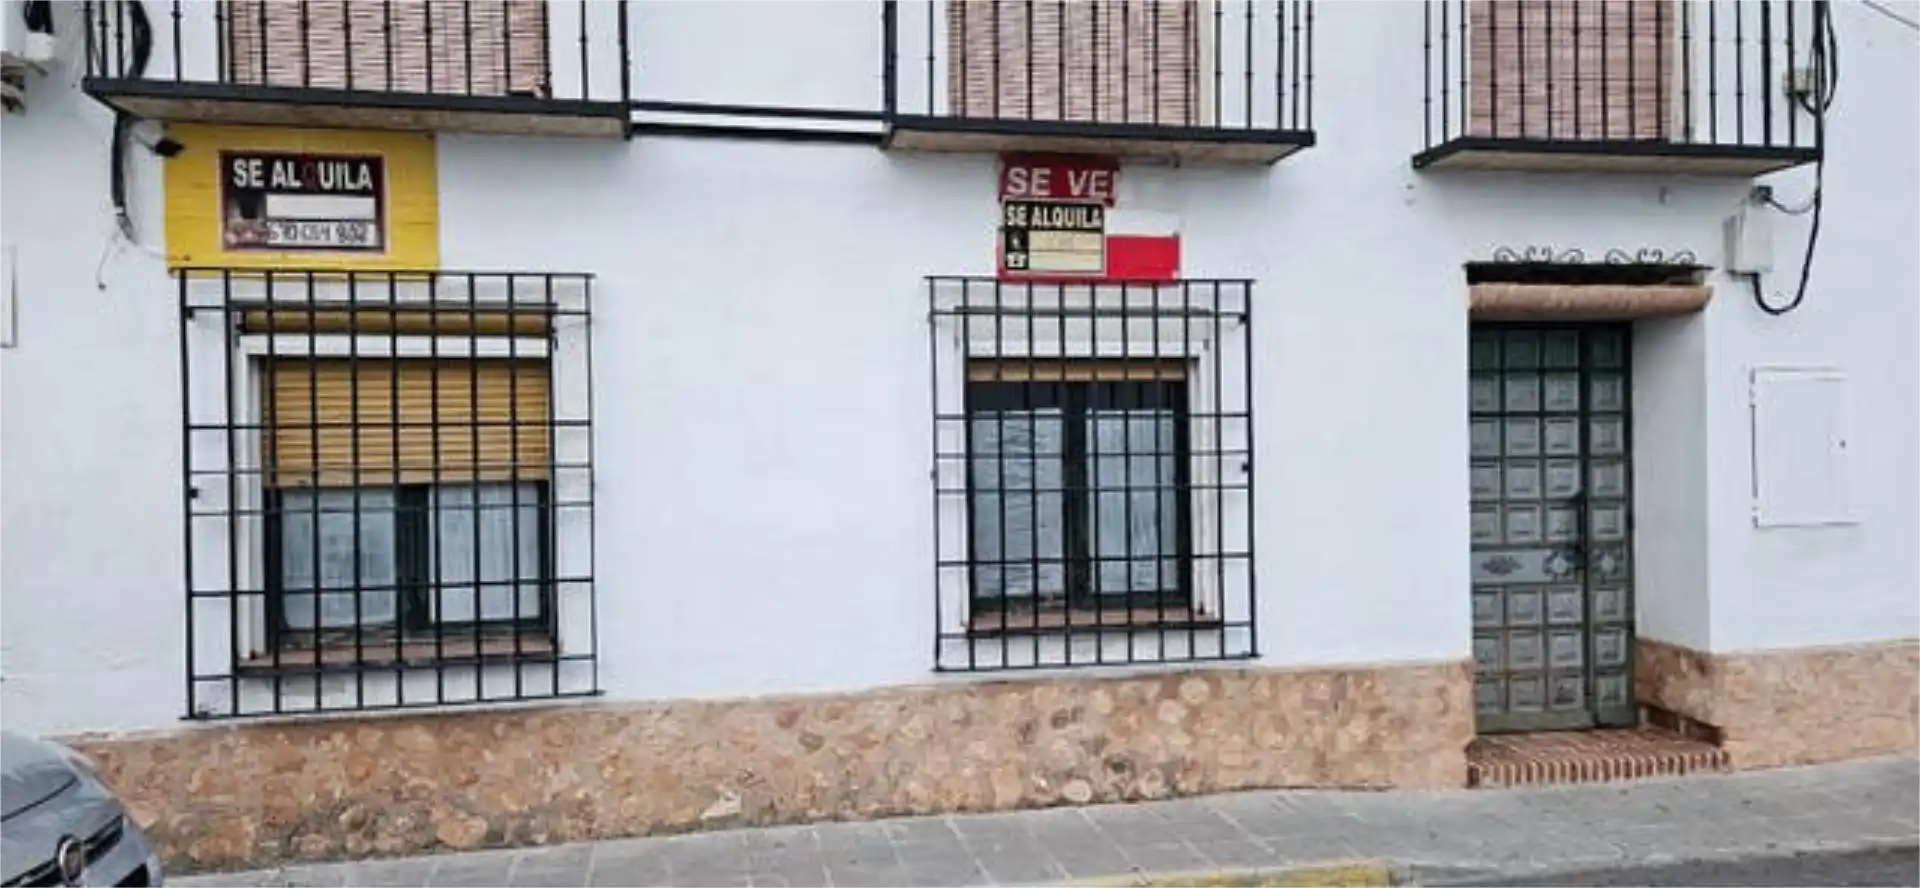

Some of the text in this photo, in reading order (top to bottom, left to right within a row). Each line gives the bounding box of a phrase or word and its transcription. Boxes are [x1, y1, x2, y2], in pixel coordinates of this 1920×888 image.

[233, 158, 264, 187] SE
[1007, 167, 1051, 196] SE
[1007, 205, 1102, 228] SE ALQUILA
